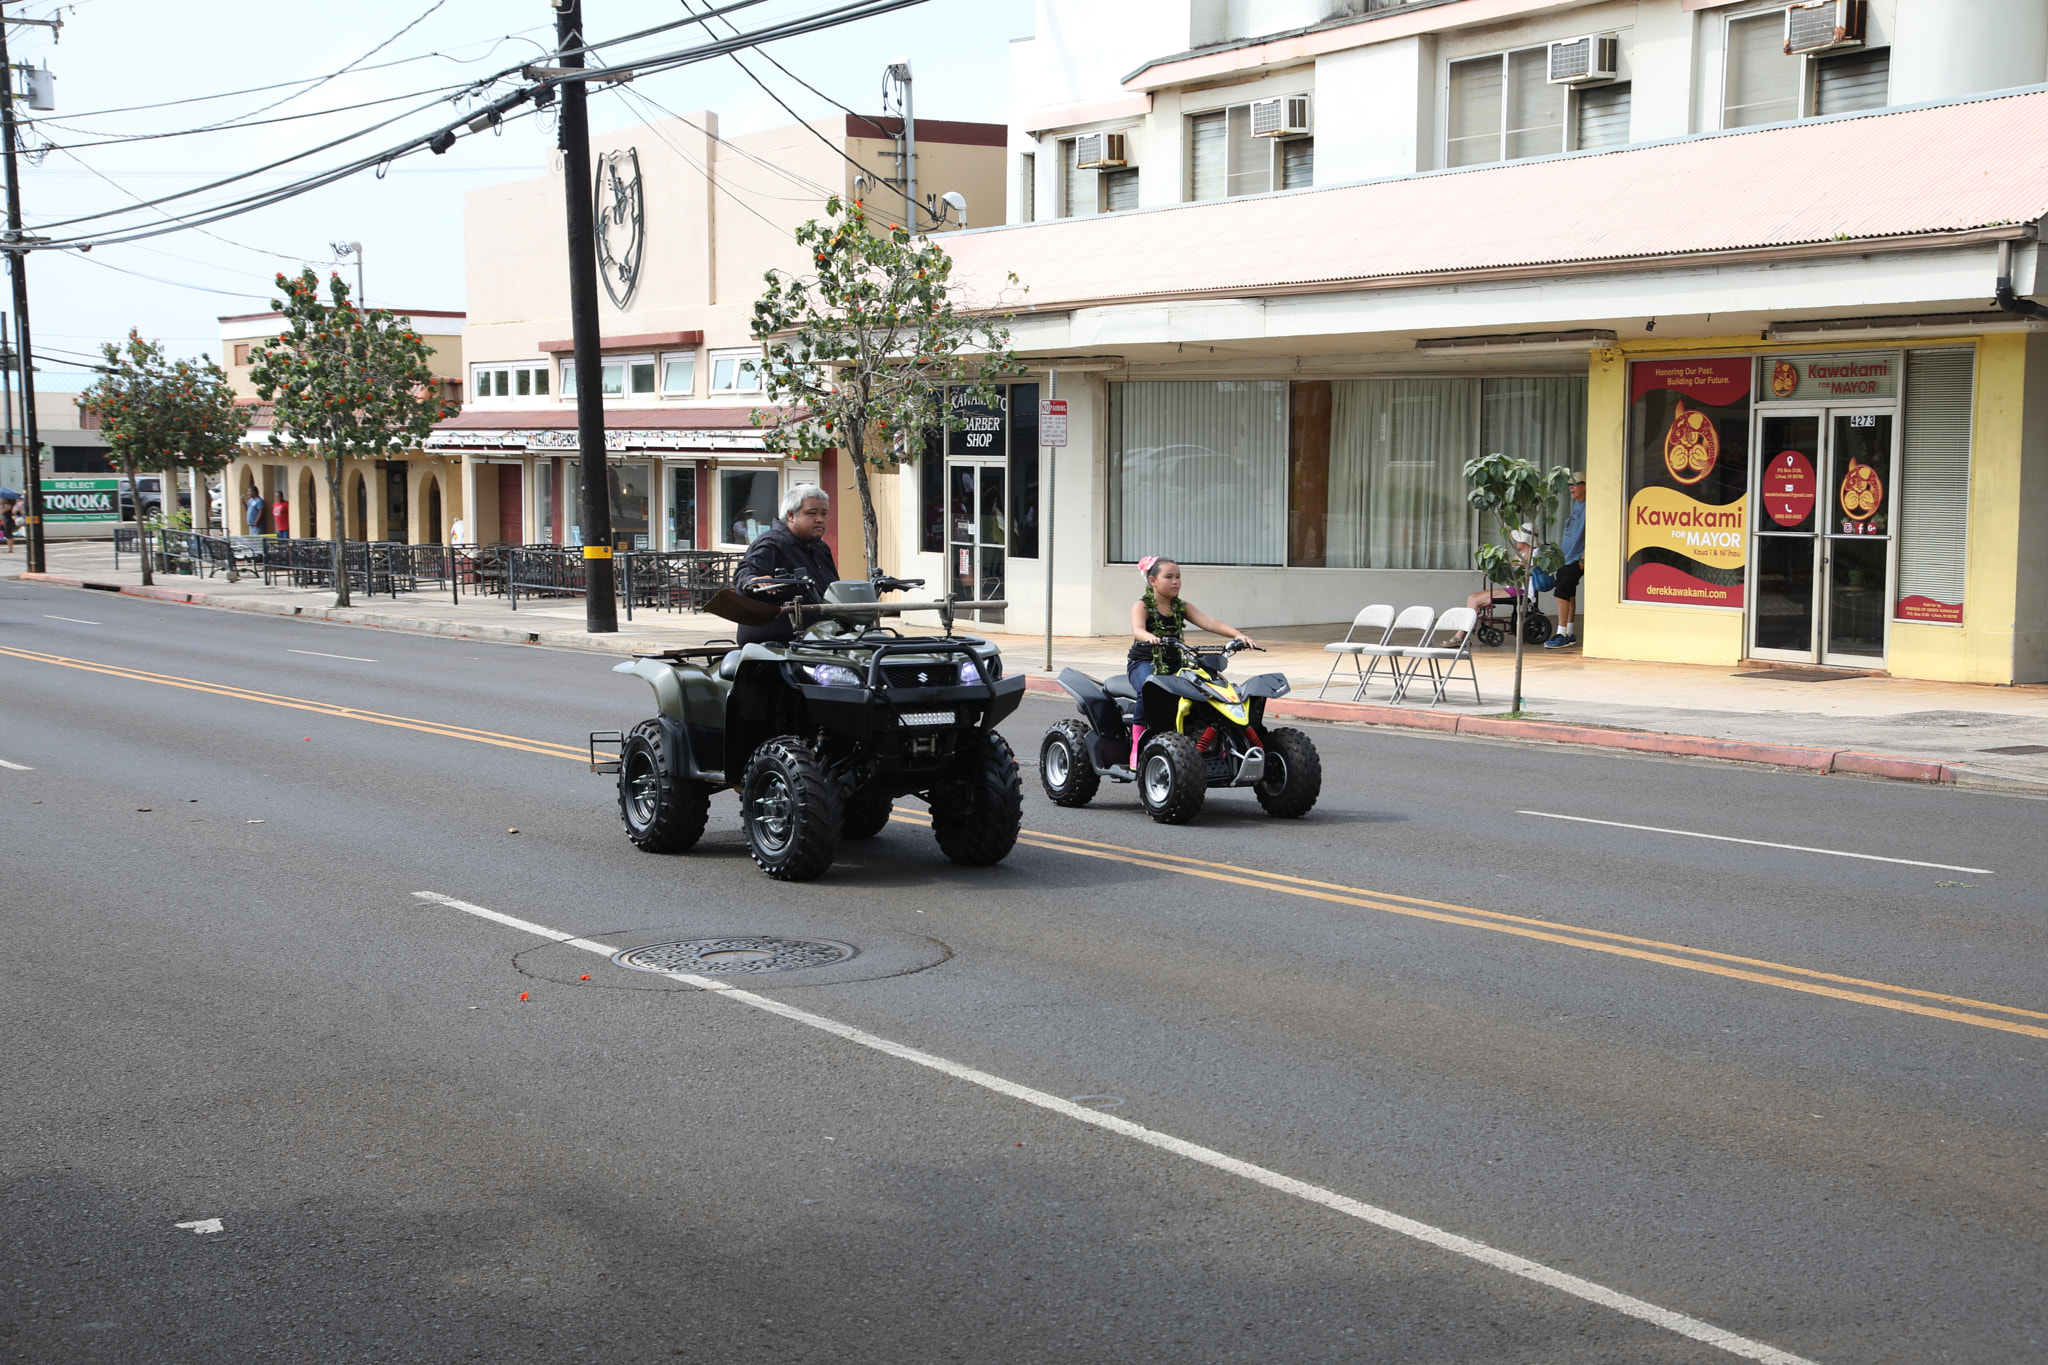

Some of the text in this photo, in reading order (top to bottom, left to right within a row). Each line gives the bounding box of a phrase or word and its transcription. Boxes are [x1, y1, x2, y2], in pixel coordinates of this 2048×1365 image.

[1655, 368, 1683, 377] Honoring
[1698, 367, 1714, 375] Past.
[1808, 360, 1888, 379] Kawakami
[1667, 377, 1730, 386] Building Our Future.
[1831, 381, 1876, 394] MAYOR
[1041, 402, 1050, 412] NO
[962, 417, 1000, 431] BARBER
[1851, 415, 1875, 426] 4273
[966, 433, 993, 447] SHOP
[42, 494, 111, 509] TOKIOKA
[1636, 505, 1743, 528] Kawakami
[1671, 530, 1741, 548] FOR MAYOR
[1646, 585, 1727, 599] derekkawakami.com
